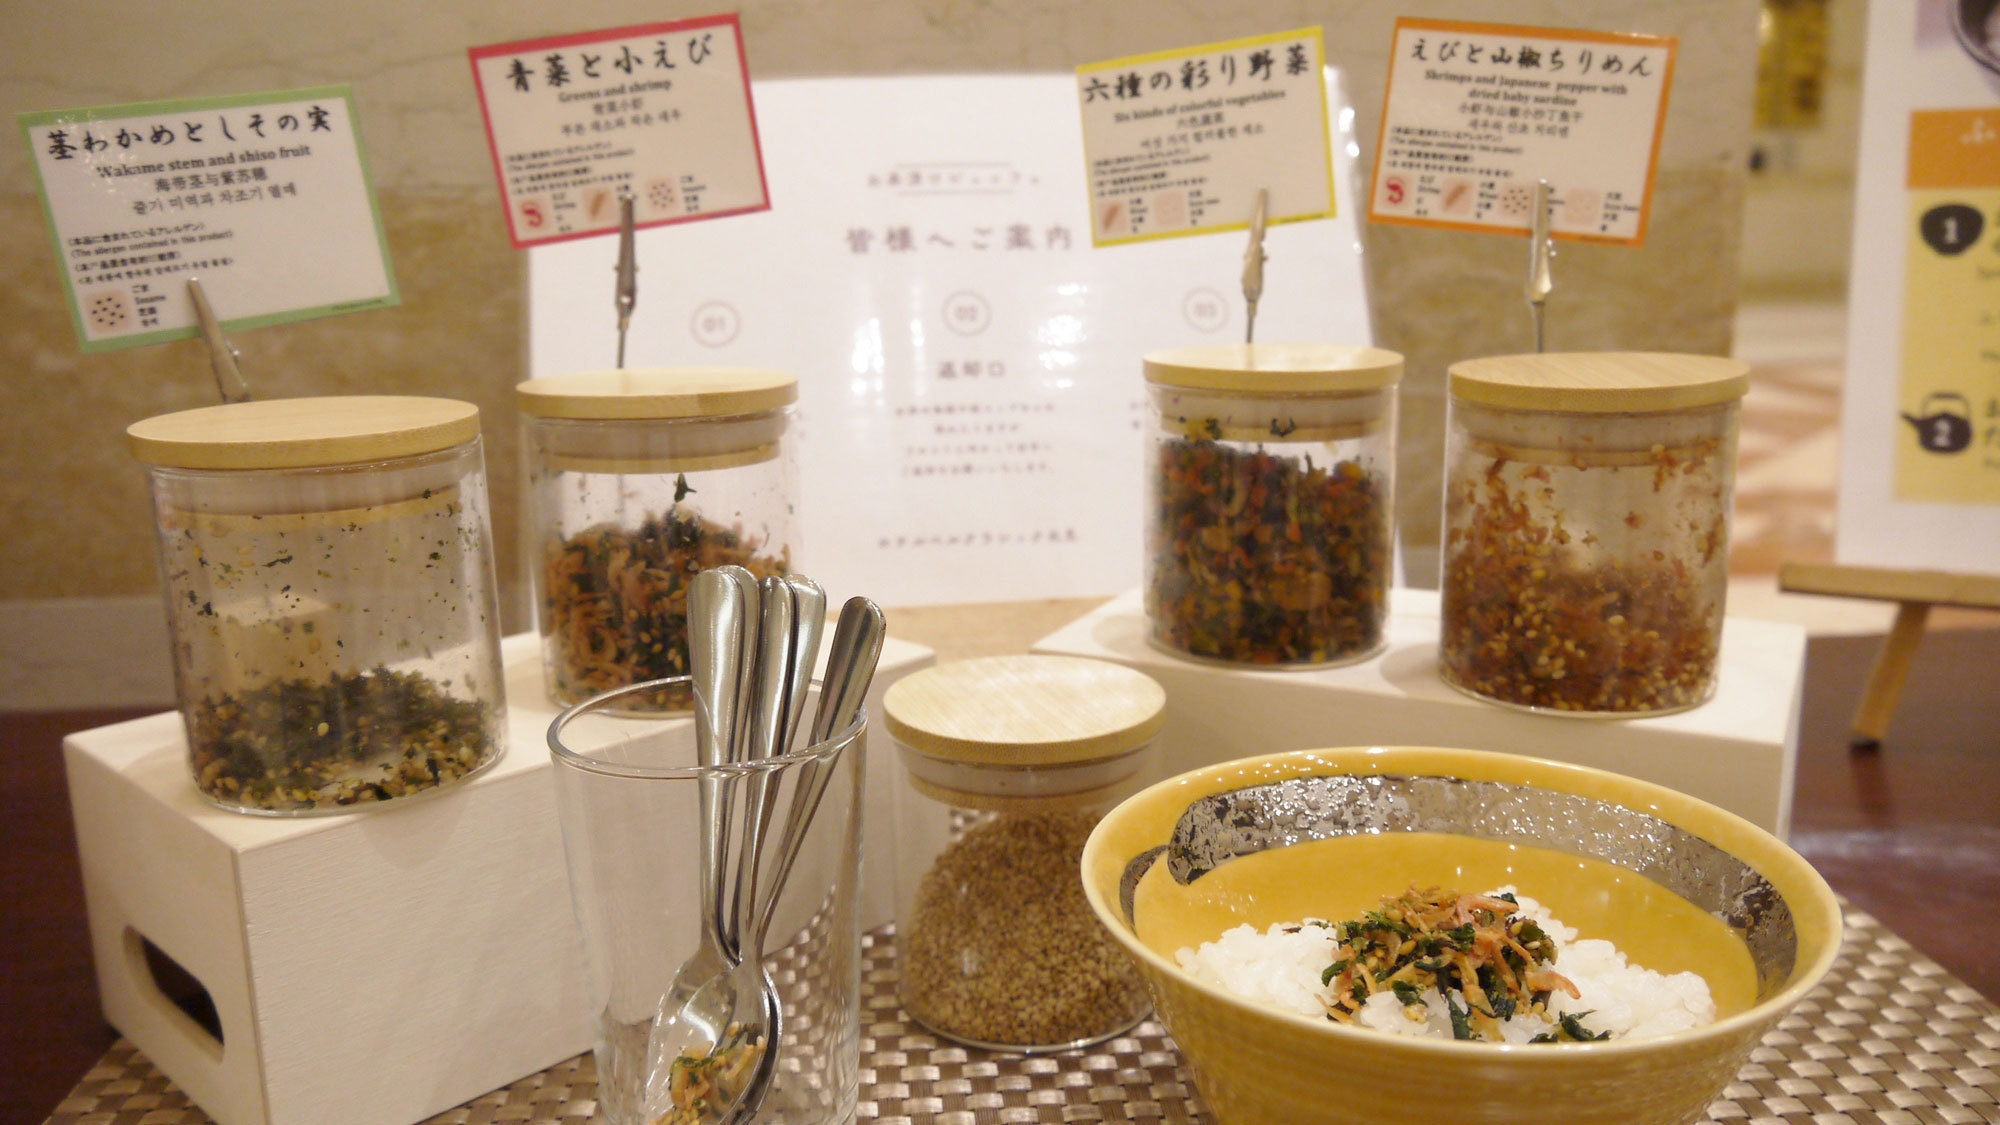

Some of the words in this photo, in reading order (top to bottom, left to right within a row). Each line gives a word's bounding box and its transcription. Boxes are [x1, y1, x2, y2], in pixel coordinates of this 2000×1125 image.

[507, 33, 711, 92] 青菜と小えび
[1412, 38, 1651, 77] えびと山椒ちりめん
[1084, 43, 1309, 103] 六種の彩り野菜
[1425, 70, 1473, 84] Shrimps
[1475, 74, 1496, 85] and
[1498, 75, 1551, 90] Japanese
[1556, 82, 1597, 95] pepper
[1601, 84, 1627, 96] with
[557, 89, 600, 102] Greens
[603, 84, 626, 97] and
[629, 79, 672, 93] shrimp
[1133, 107, 1163, 119] kinds
[1166, 105, 1177, 115] of
[1226, 89, 1286, 106] vegetables
[1468, 88, 1500, 101] dried
[1503, 91, 1532, 104] baby
[1533, 94, 1577, 107] sardine
[48, 106, 332, 160] 茎わかめとしその実
[97, 162, 164, 178] Wakame
[168, 158, 205, 171] stem
[208, 154, 235, 167] and
[239, 149, 276, 163] shiso
[279, 145, 310, 159] fruit
[847, 224, 1073, 254] 皆様へご案内
[1944, 217, 1958, 245] 1
[1934, 418, 1950, 447] 2
